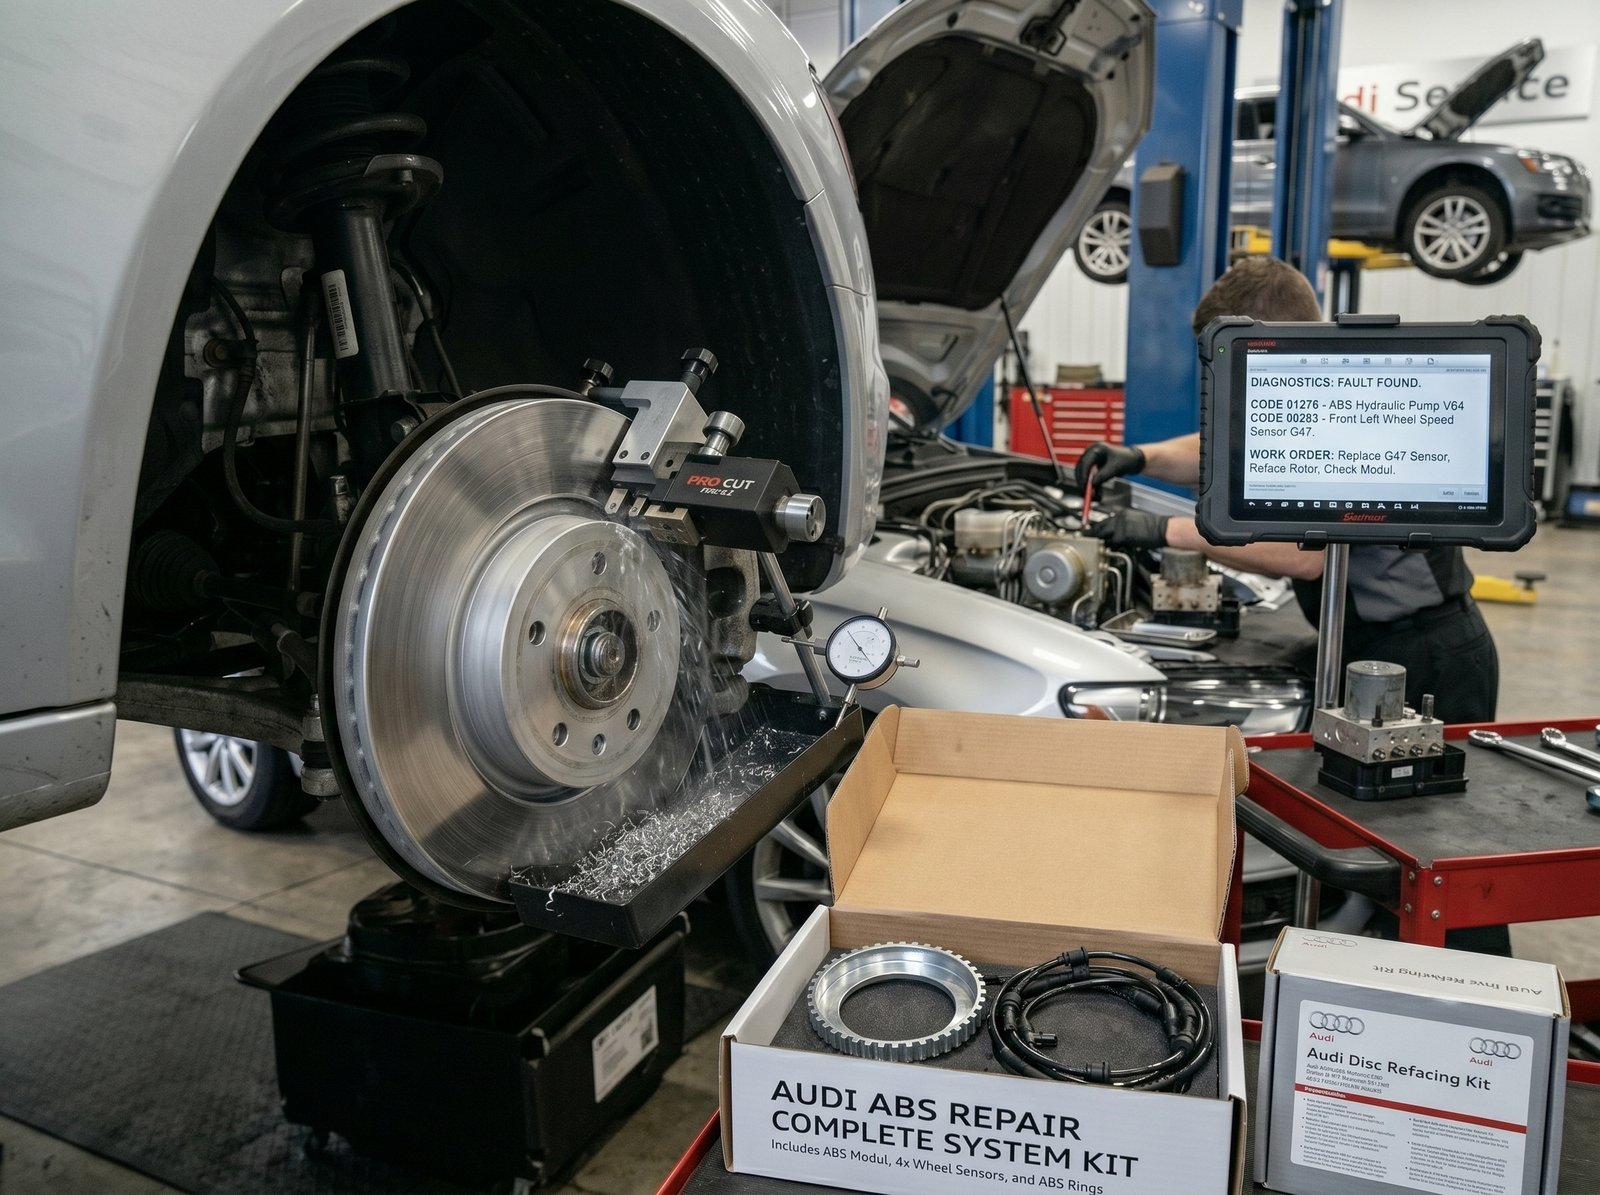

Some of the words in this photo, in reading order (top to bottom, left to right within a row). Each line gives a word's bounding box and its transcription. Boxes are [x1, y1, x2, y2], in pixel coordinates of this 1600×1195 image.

[1395, 75, 1569, 112] Sece
[1251, 377, 1334, 388] DIAGNOSTICS:
[1337, 378, 1373, 388] FAULT
[1377, 378, 1422, 388] FOUND.
[1251, 399, 1283, 410] CODE
[1287, 400, 1319, 410] 01276
[1329, 400, 1352, 410] ABS
[1356, 400, 1405, 412] Hydraulic
[1409, 401, 1440, 412] Pump
[1443, 401, 1464, 411] V64
[1251, 413, 1283, 423] CODE
[1286, 413, 1319, 423] 00283
[1329, 414, 1357, 424] Front
[1360, 414, 1380, 424] Left
[1383, 414, 1416, 424] Wheel
[1420, 414, 1454, 427] Speed
[1250, 426, 1287, 437] Sensor
[1290, 427, 1315, 437] G47.
[1249, 449, 1286, 460] WORK
[1289, 450, 1334, 460] ORDER:
[1338, 450, 1381, 462] Replace
[1384, 451, 1407, 461] G47
[1410, 451, 1451, 463] Sensor,
[1249, 463, 1286, 473] Reface
[1290, 463, 1320, 475] Rotor,
[1324, 464, 1357, 474] Check
[1360, 464, 1396, 475] Modul.
[687, 475, 721, 487] PRO
[723, 478, 755, 490] CUT
[1309, 1032, 1335, 1042] Audi
[1307, 1047, 1343, 1064] Audi
[1349, 1054, 1382, 1071] Disc
[1387, 1061, 1460, 1087] Refacing
[1466, 1075, 1491, 1091] Kit
[1469, 1057, 1493, 1067] Audi
[771, 1080, 857, 1111] AUDI
[868, 1093, 937, 1121] ABS
[950, 1102, 1081, 1141] REPAIR
[772, 1110, 934, 1151] COMPLETE
[944, 1133, 1070, 1170] SYSTEM
[1083, 1151, 1139, 1178] KIT
[771, 1139, 820, 1156] Includes
[823, 1146, 847, 1159] ABS
[851, 1150, 892, 1167] Modul,
[895, 1157, 910, 1168] 4x
[912, 1158, 952, 1174] Wheel
[956, 1165, 1008, 1183] Sensors,
[1012, 1174, 1035, 1185] and
[1038, 1176, 1064, 1189] ABS
[1068, 1179, 1104, 1195] Rings
